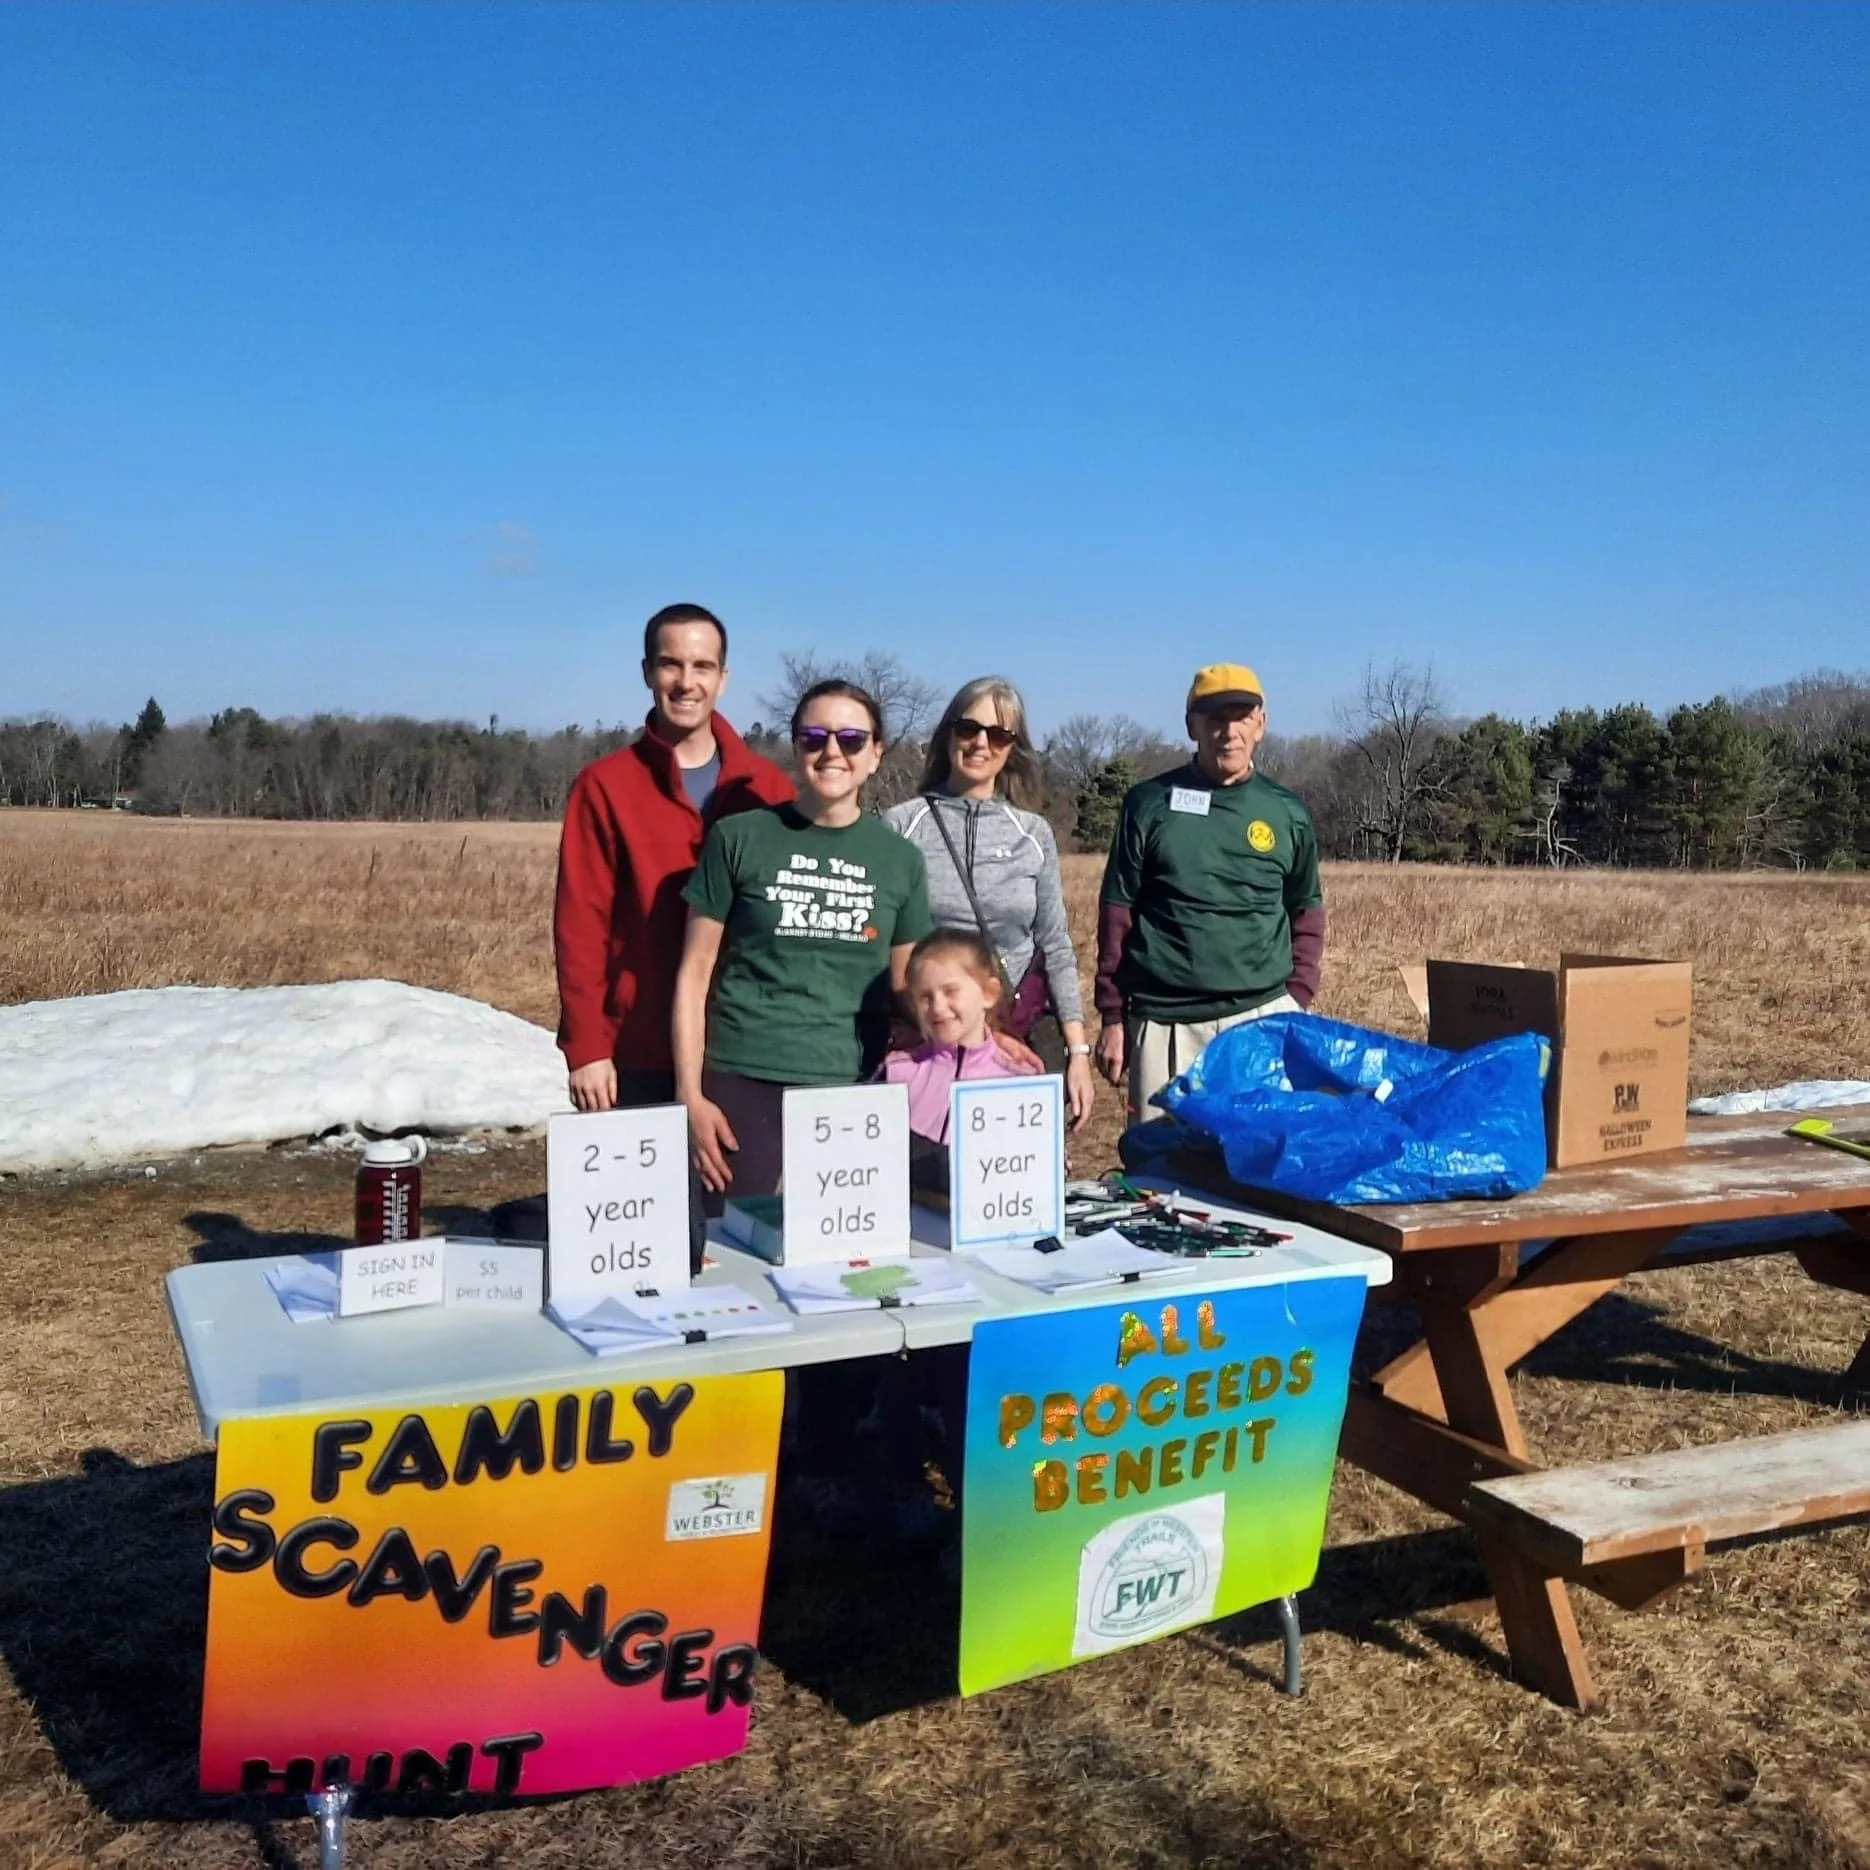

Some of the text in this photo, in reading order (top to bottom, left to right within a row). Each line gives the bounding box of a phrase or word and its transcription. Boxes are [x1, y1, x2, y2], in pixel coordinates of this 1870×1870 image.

[775, 869, 877, 894] Remember
[790, 853, 866, 879] Do You
[765, 885, 815, 904] Your
[778, 902, 870, 933] Kiss?
[815, 1115, 832, 1143] 5
[865, 1113, 881, 1140] 8
[971, 1106, 986, 1132] 8
[1017, 1102, 1044, 1128] 12
[584, 1144, 601, 1172] 2
[639, 1138, 657, 1168] 5
[979, 1153, 1036, 1184] year
[816, 1166, 880, 1198] year
[585, 1197, 655, 1233] year
[820, 1204, 877, 1235] olds
[983, 1190, 1033, 1220] olds
[356, 1252, 436, 1277] SIGN IN
[590, 1240, 652, 1274] olds
[371, 1278, 419, 1300] HERE
[455, 1284, 523, 1301] per child
[1116, 1300, 1227, 1368] ALL
[999, 1346, 1315, 1449] PROCEEDS
[311, 1382, 695, 1503] FAMILY
[1031, 1417, 1277, 1513] BENEFIT
[671, 1509, 756, 1531] WEBSTER
[206, 1487, 761, 1715] SCAVENGER
[1114, 1568, 1187, 1613] FWT
